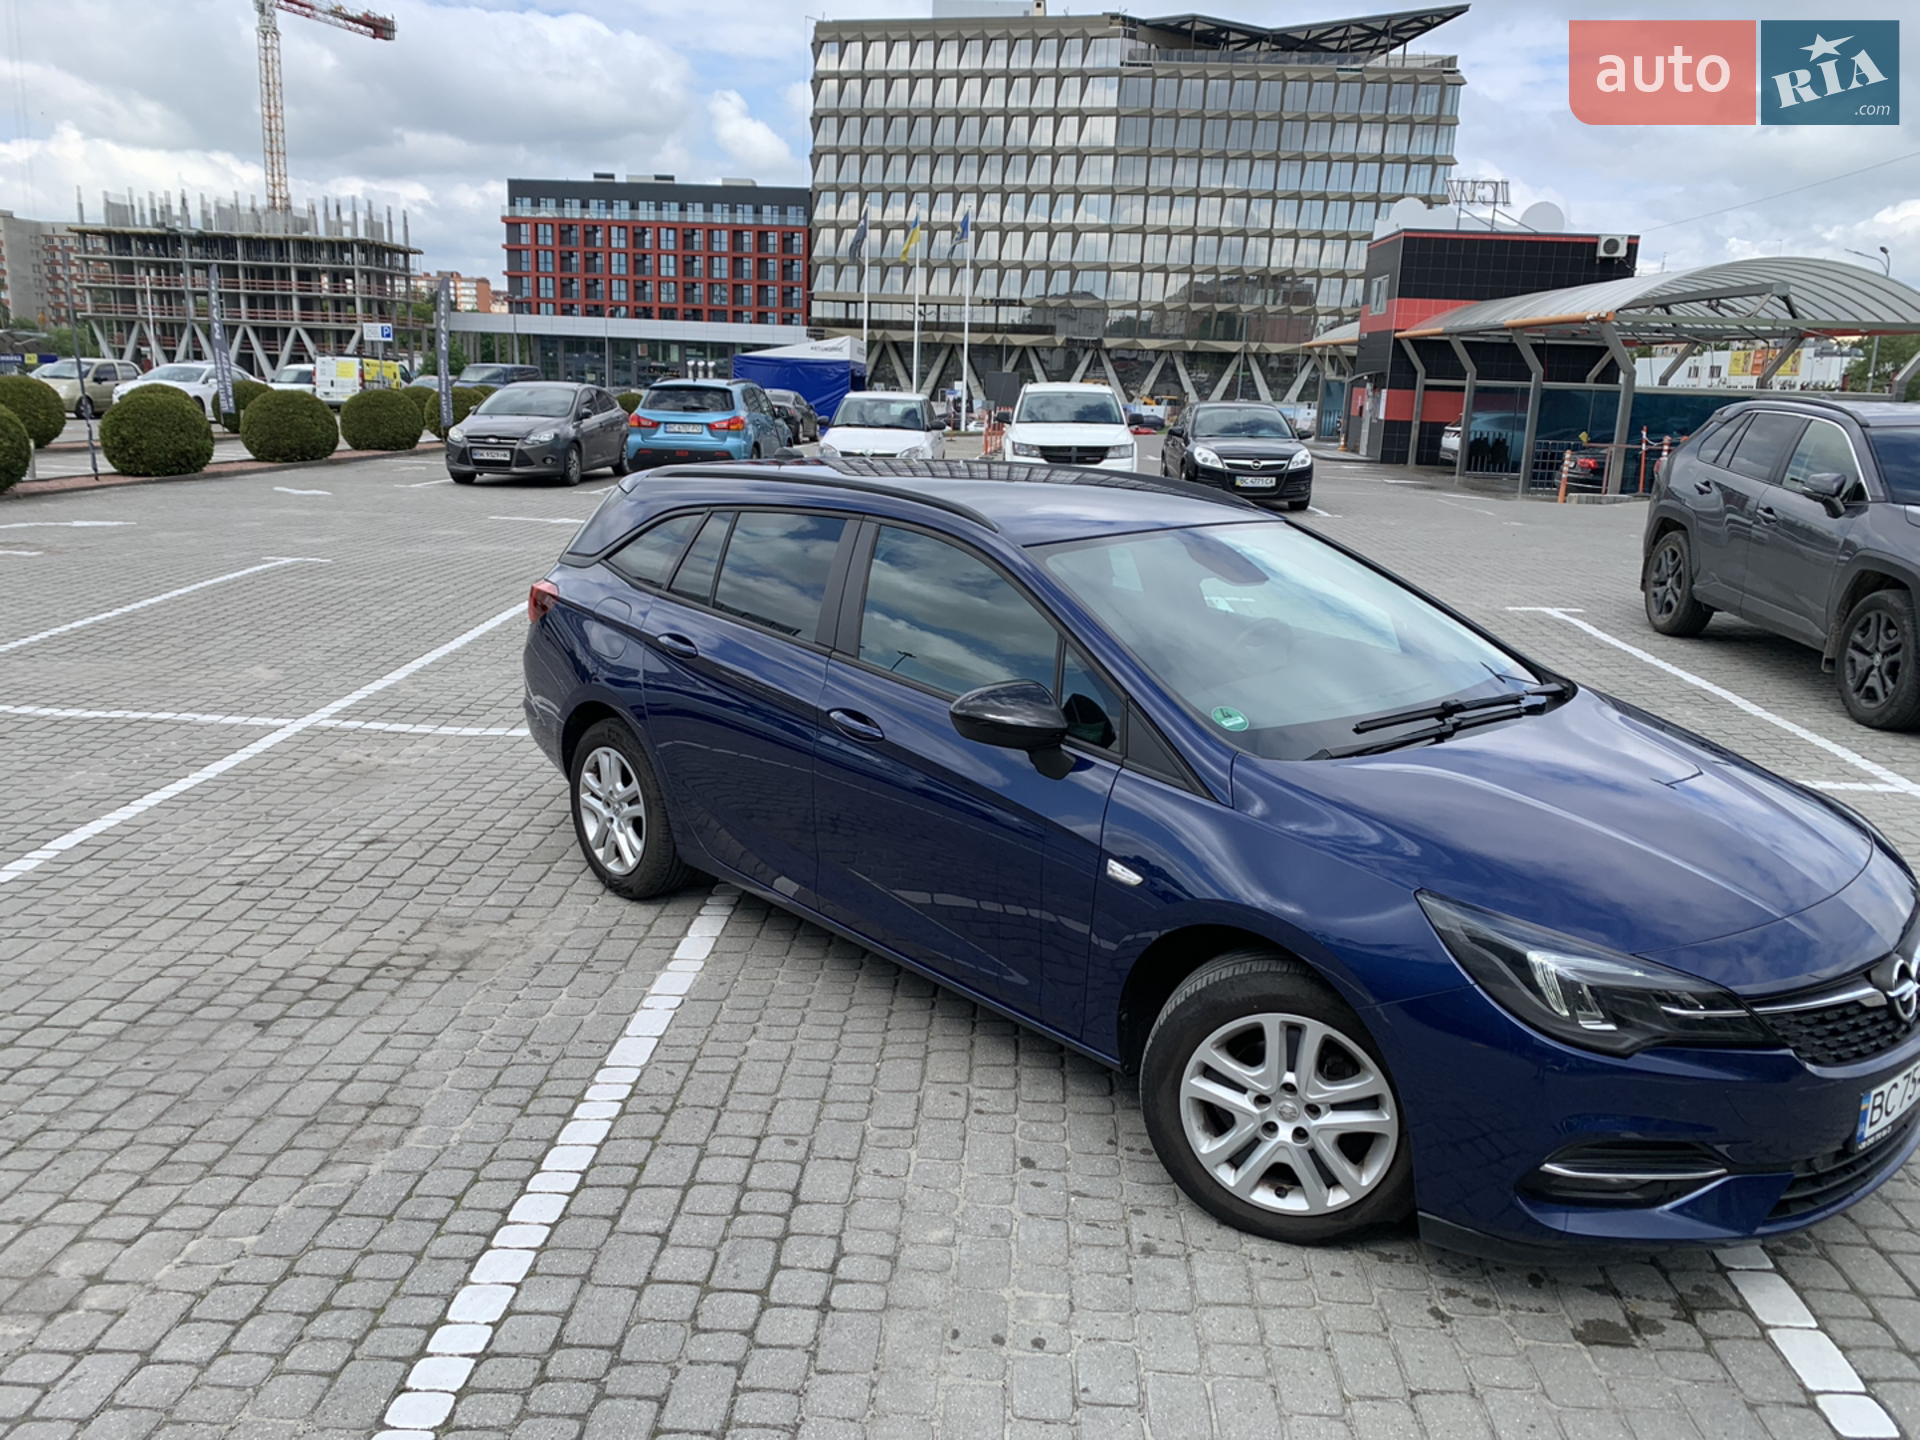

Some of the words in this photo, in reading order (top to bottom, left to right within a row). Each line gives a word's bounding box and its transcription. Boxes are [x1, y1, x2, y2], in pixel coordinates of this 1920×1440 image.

[383, 326, 390, 337] P
[1220, 708, 1232, 718] 4
[1869, 1082, 1898, 1129] BC
[1899, 1065, 1920, 1109] 75
